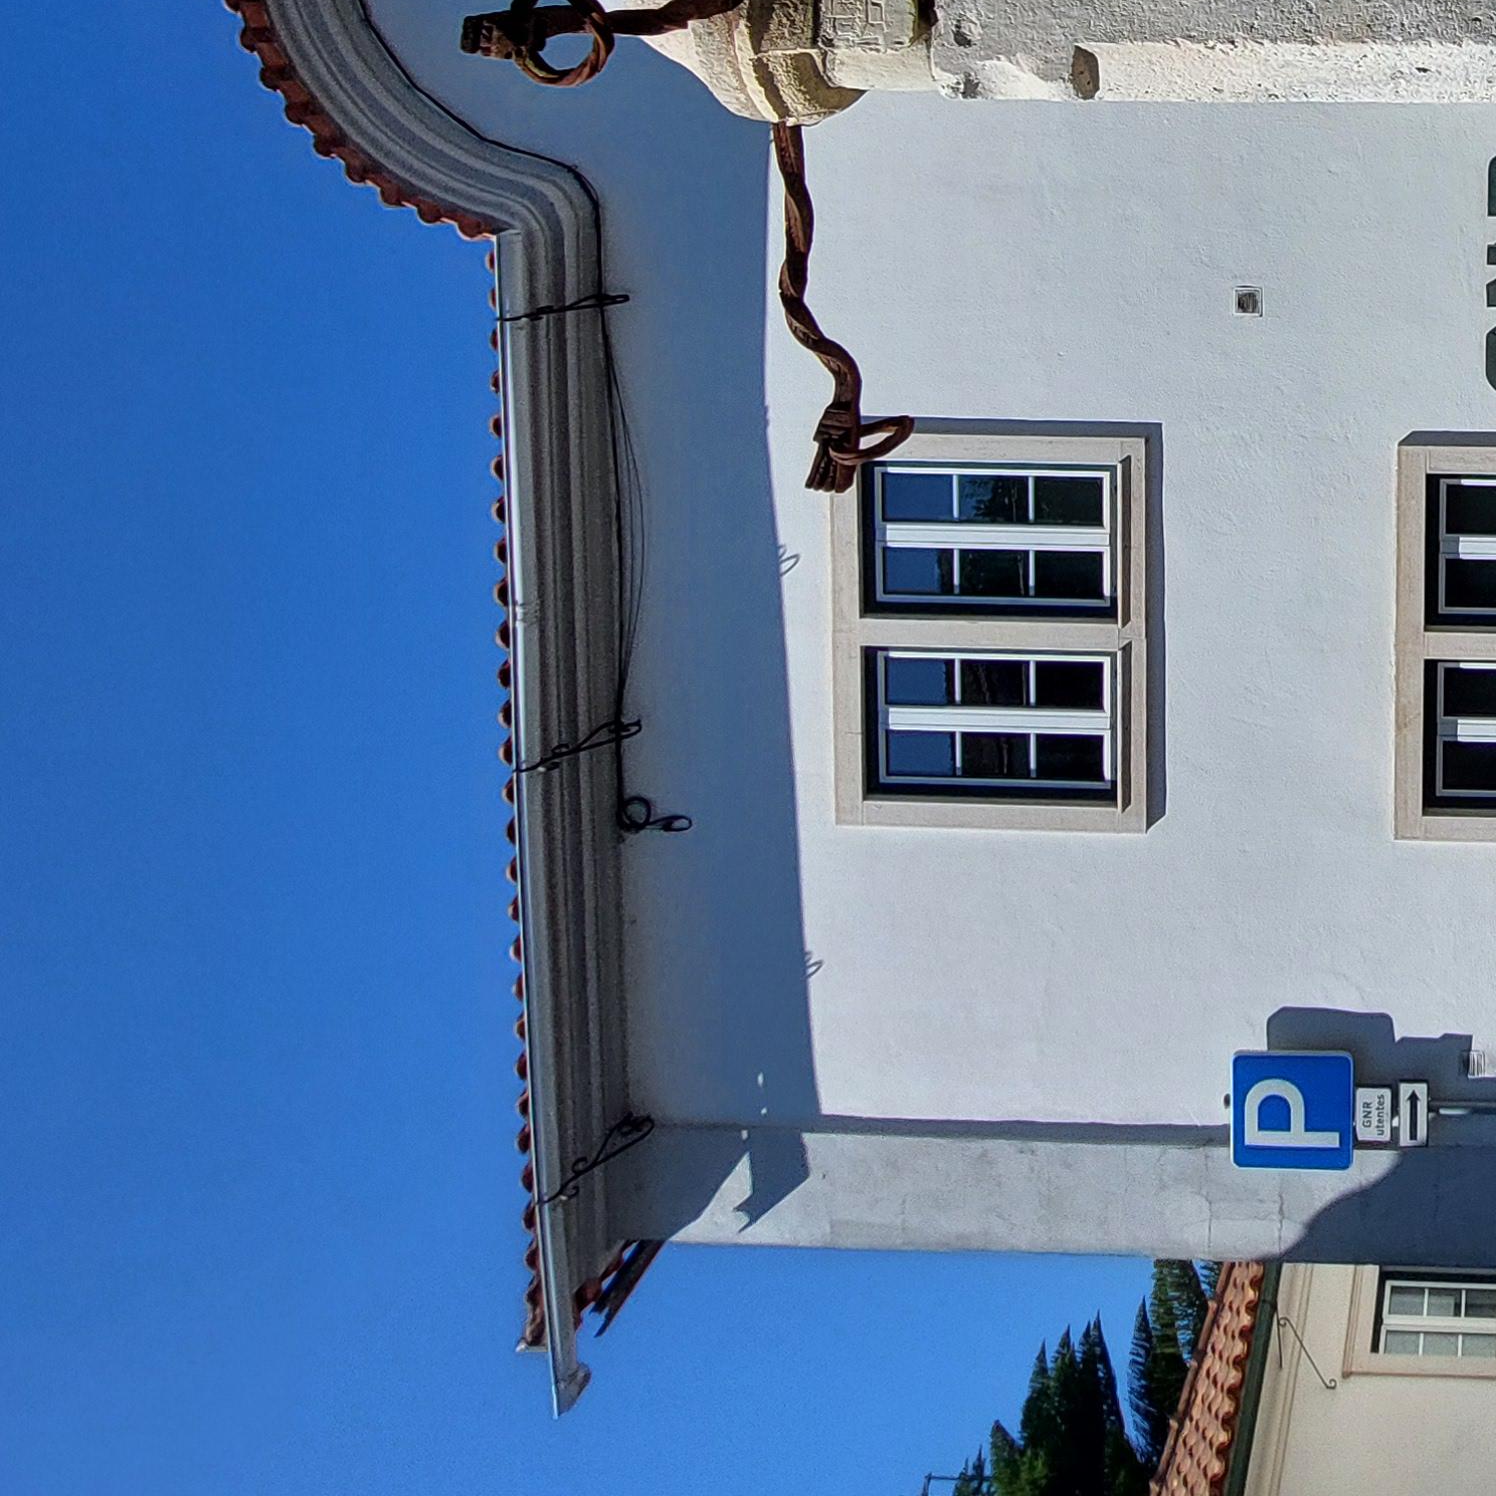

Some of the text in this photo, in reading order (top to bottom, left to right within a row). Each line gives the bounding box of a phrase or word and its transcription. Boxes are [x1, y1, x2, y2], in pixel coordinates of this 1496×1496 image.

[1244, 1078, 1340, 1148] P
[1362, 1102, 1372, 1128] GNR
[1374, 1094, 1385, 1136] utentes
